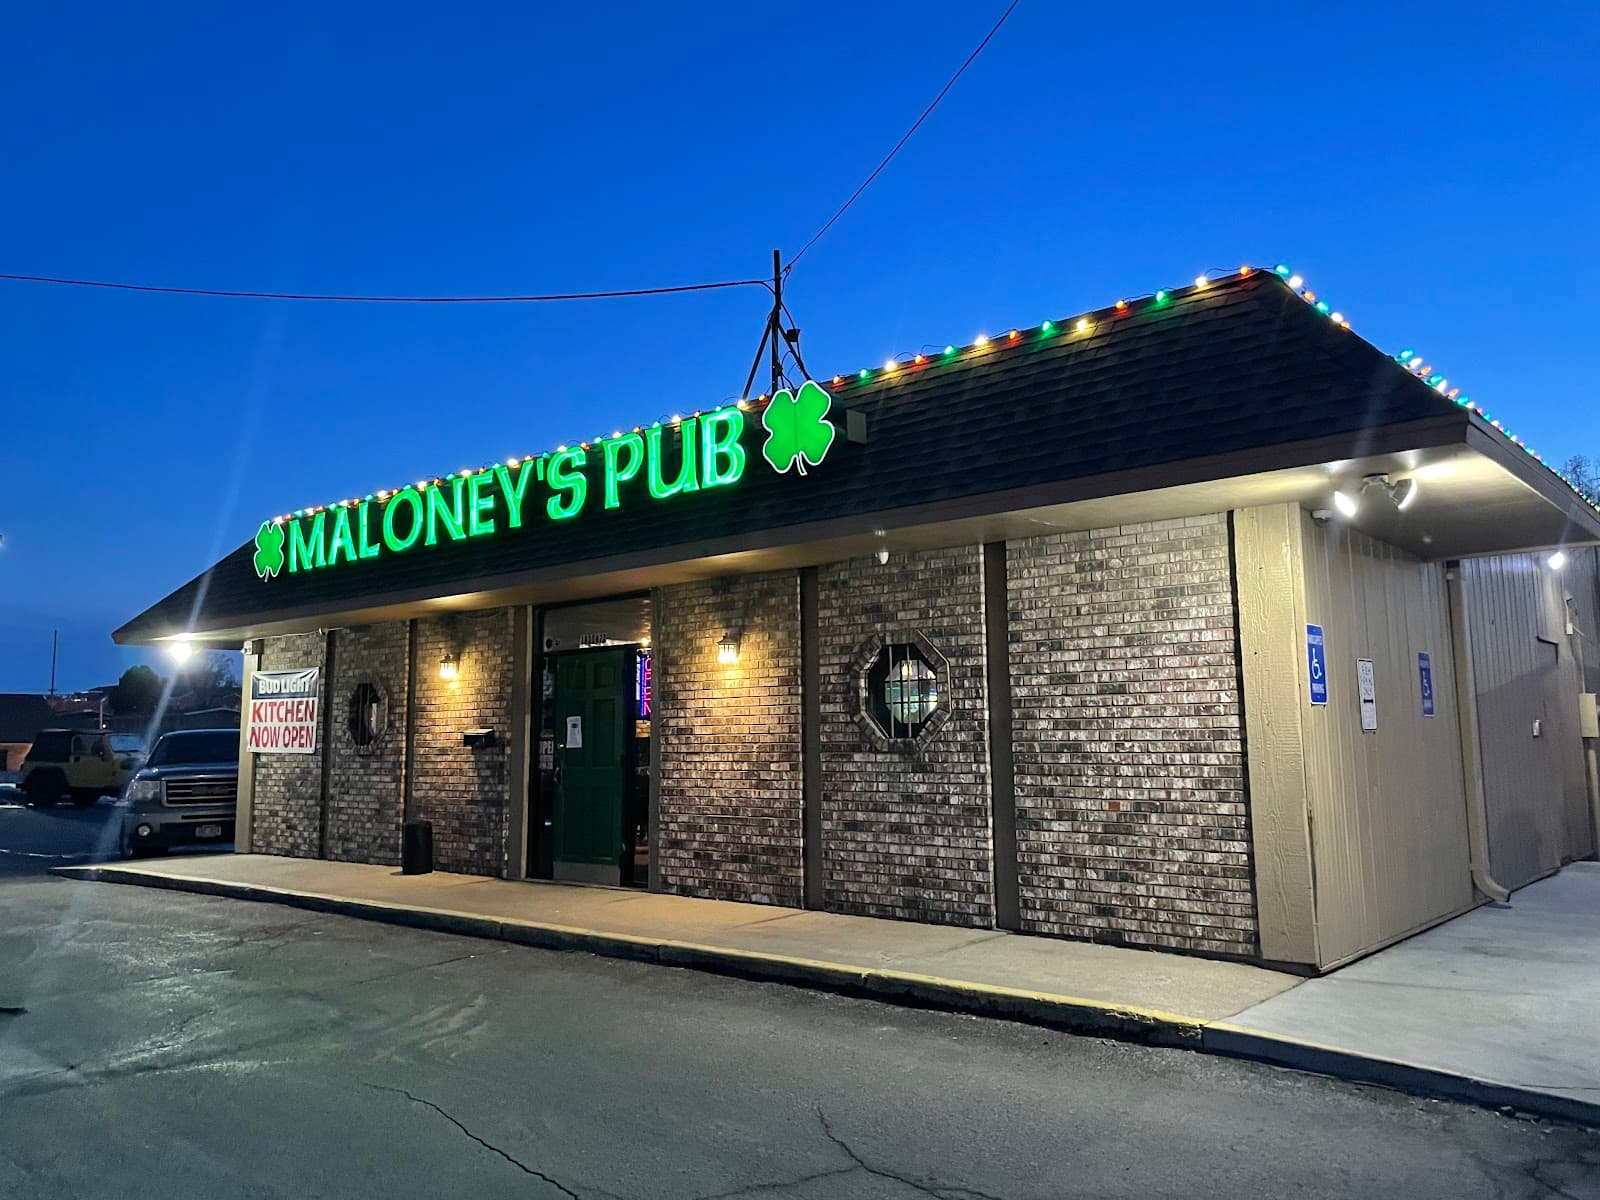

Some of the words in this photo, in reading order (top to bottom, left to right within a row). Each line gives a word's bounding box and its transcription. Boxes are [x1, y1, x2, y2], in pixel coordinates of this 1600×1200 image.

[288, 445, 588, 573] MALONEY'S
[603, 405, 747, 510] PUB
[259, 679, 280, 694] BUD
[280, 678, 310, 693] LIGHT
[252, 700, 315, 723] KITCHEN
[249, 726, 281, 748] NOW
[282, 726, 314, 748] OPEN
